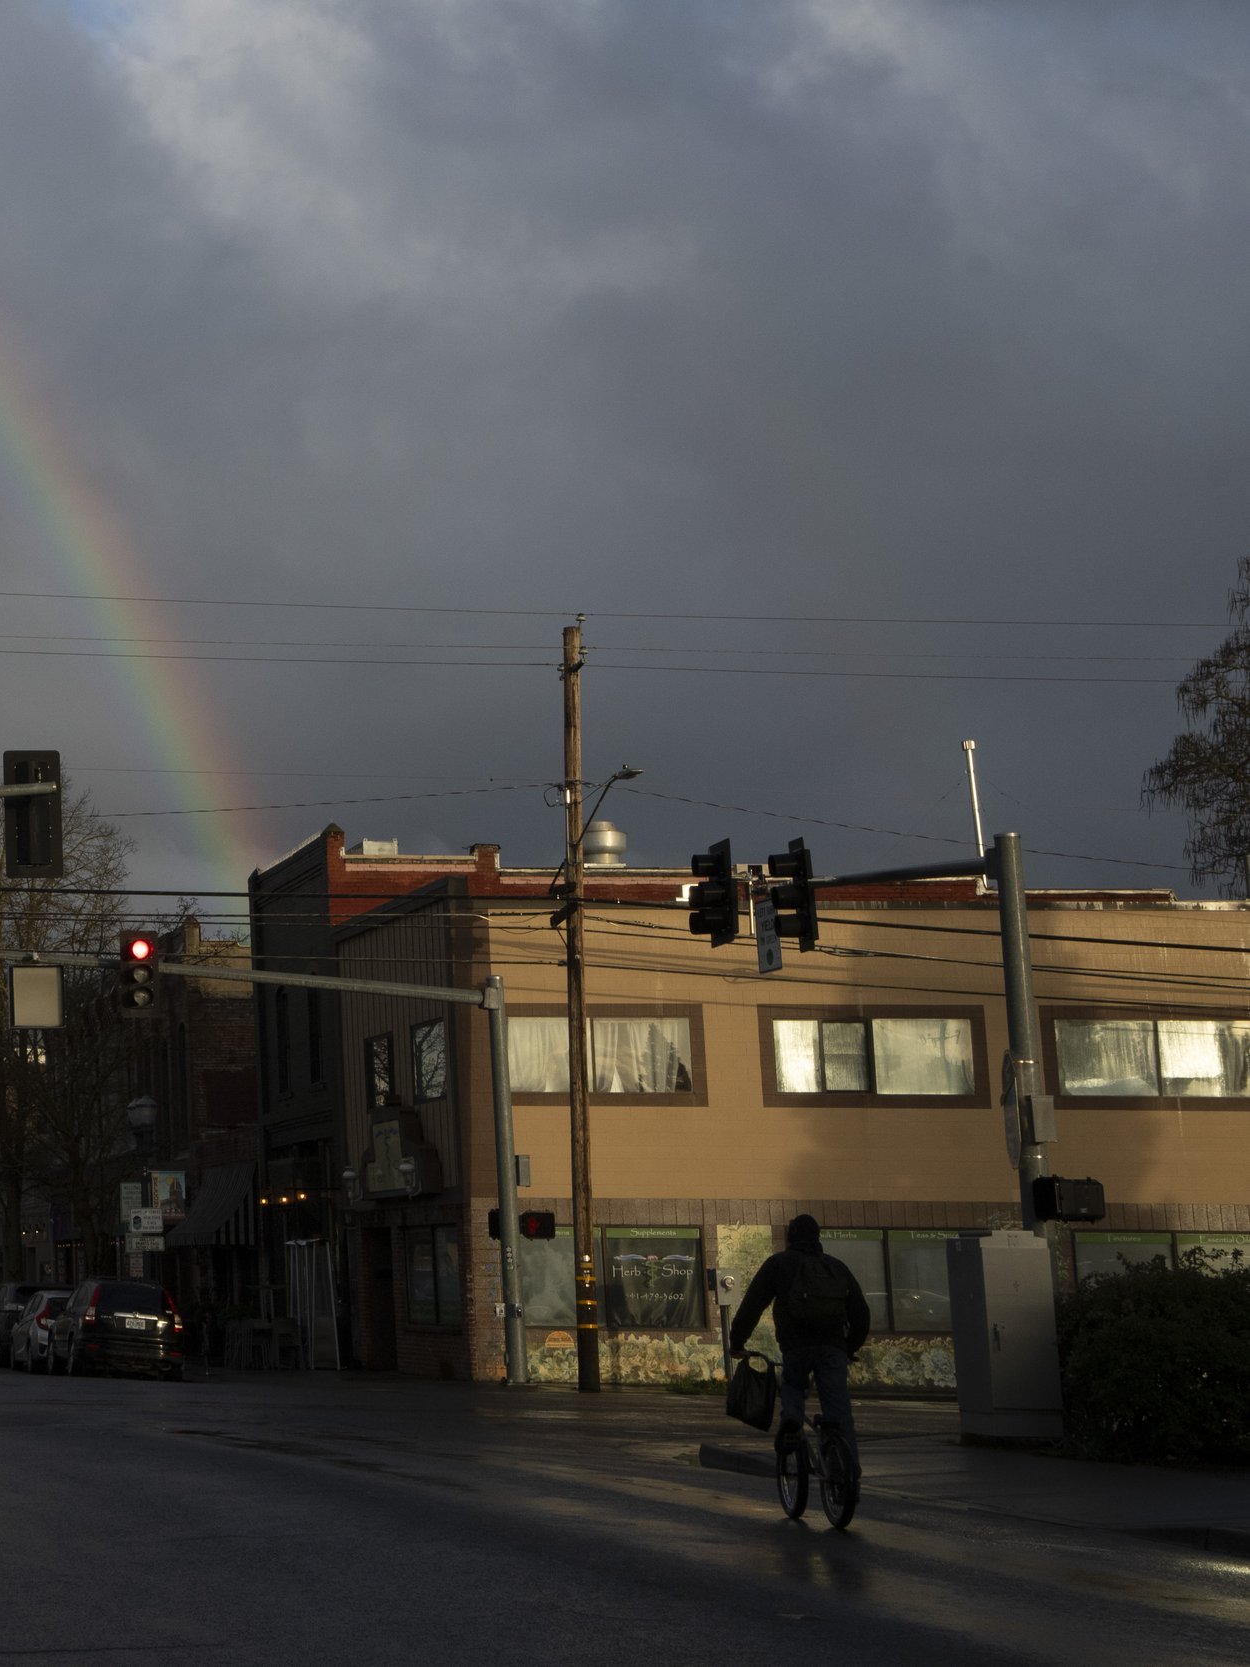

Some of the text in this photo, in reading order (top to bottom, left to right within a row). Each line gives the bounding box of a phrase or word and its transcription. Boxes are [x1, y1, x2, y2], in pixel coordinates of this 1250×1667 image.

[629, 1228, 677, 1238] Supplements
[833, 1230, 858, 1239] Herbs
[909, 1230, 929, 1240] Teas
[1199, 1234, 1235, 1244] Essential
[612, 1264, 694, 1280] Herb Shop
